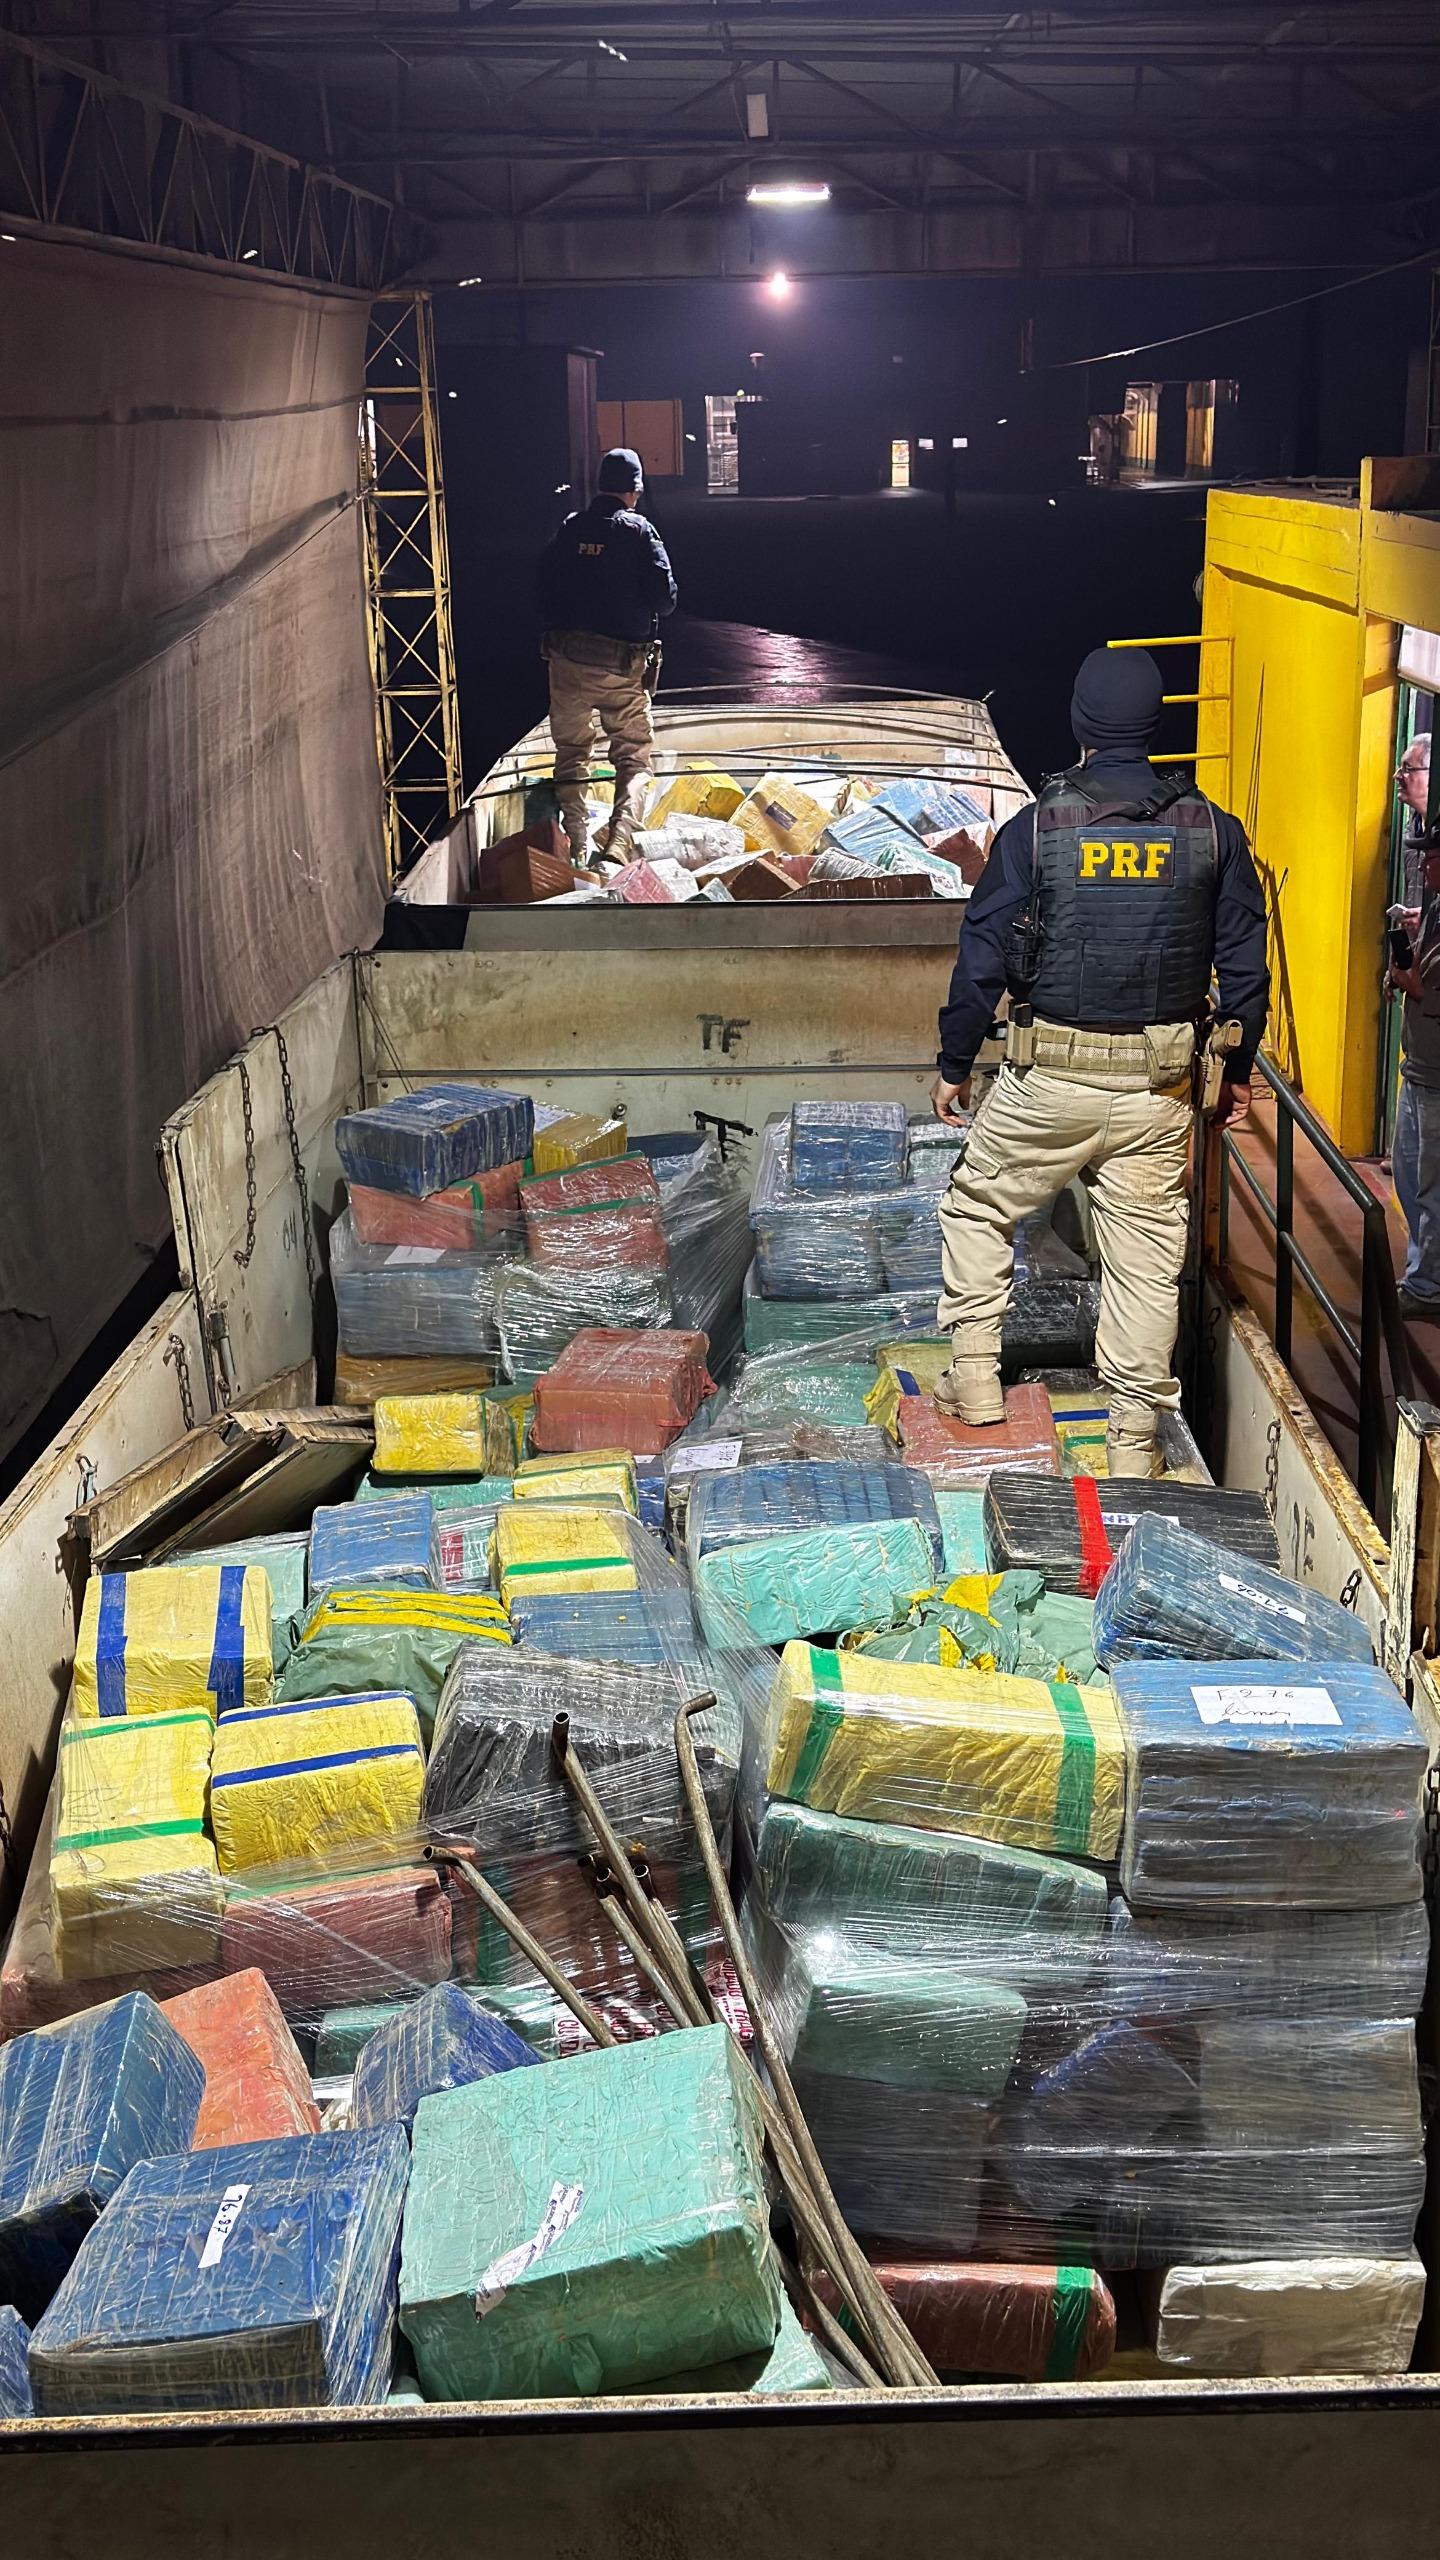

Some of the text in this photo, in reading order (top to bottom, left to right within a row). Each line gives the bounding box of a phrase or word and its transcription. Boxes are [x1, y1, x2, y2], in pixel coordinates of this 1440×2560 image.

[578, 543, 605, 556] PRF
[1080, 842, 1171, 878] PRF
[722, 1957, 744, 1999] UIDADO
